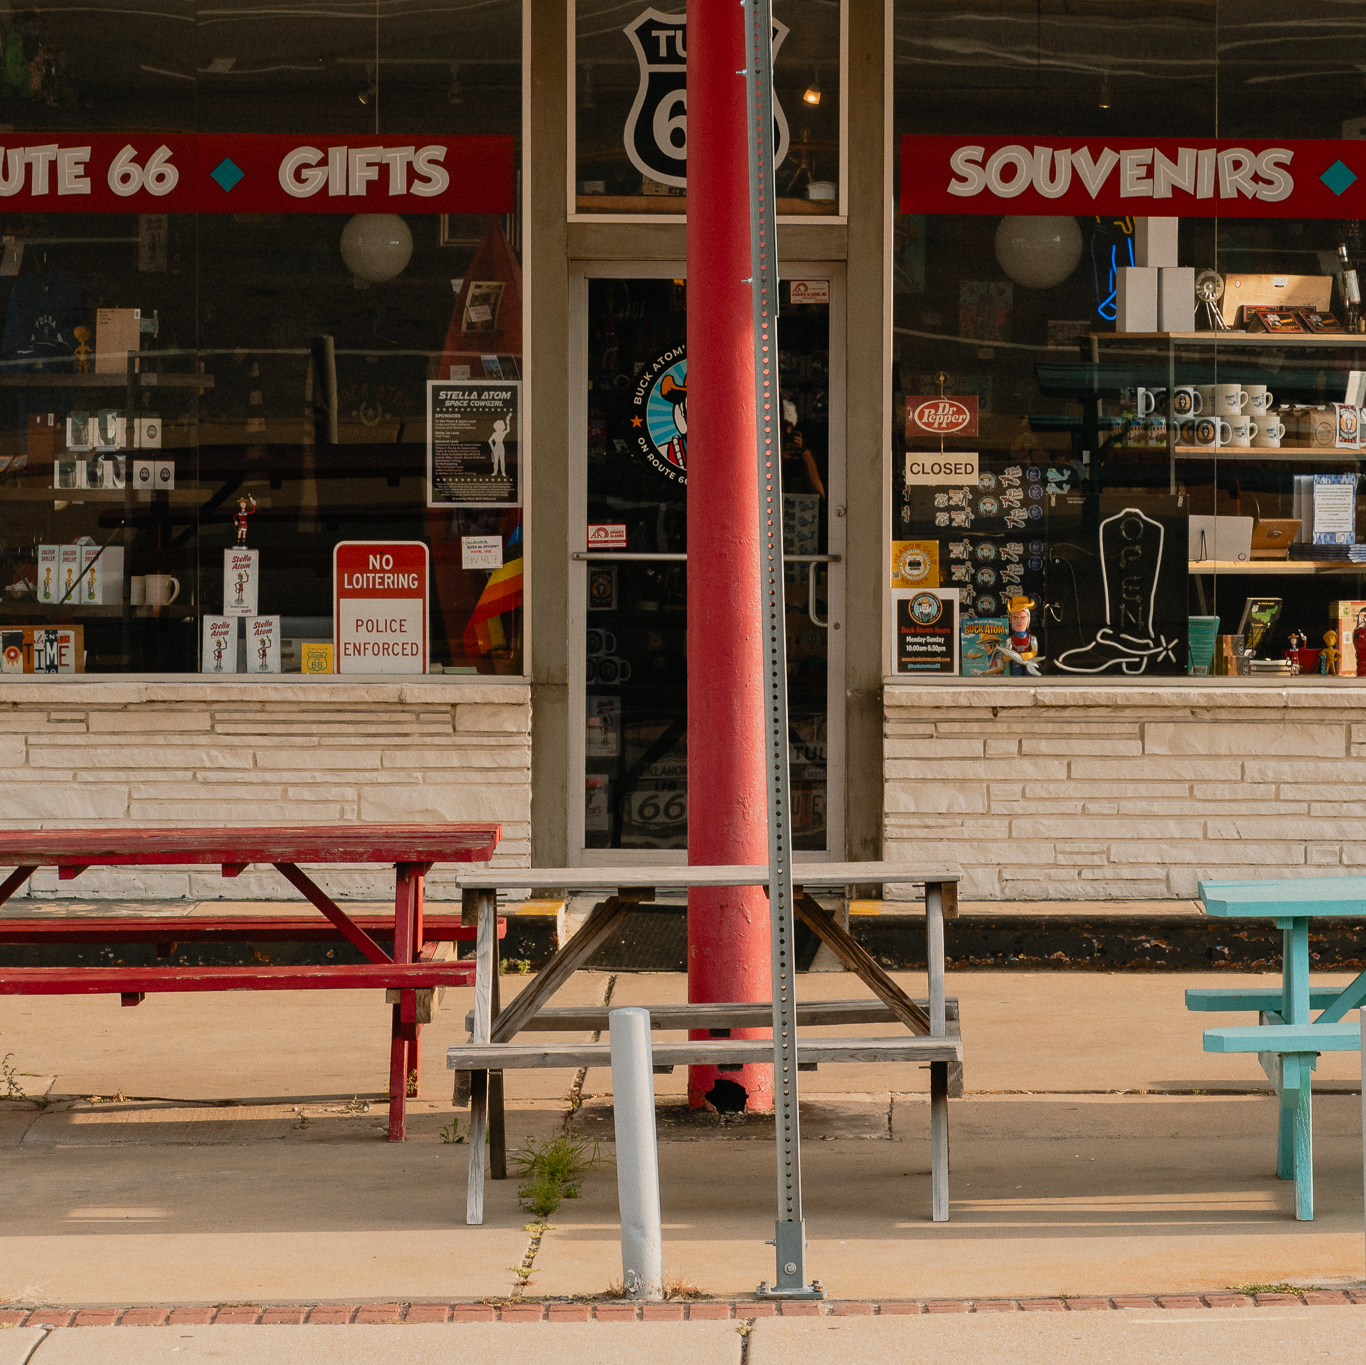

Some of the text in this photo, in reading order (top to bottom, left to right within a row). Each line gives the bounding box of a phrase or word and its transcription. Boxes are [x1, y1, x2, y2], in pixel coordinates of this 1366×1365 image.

[107, 144, 179, 196] 66
[278, 145, 450, 198] GIFTS
[947, 145, 1295, 202] SOUVENIRS
[35, 315, 57, 330] TULSA
[634, 344, 686, 405] BUCK ATOM'
[438, 391, 511, 400] STELLA ATOM
[921, 403, 966, 428] Dr Pepper
[637, 437, 649, 453] ON
[646, 452, 677, 481] ROUTE
[910, 462, 974, 475] CLOSED
[231, 554, 251, 563] Stella
[369, 554, 393, 570] NO
[232, 562, 251, 570] Atom
[344, 573, 419, 589] LOITERING
[210, 622, 230, 630] Stella
[253, 619, 273, 629] Stella
[355, 619, 407, 633] POLICE
[964, 624, 1006, 635] BUCK ATOM
[211, 629, 229, 637] Atom
[254, 628, 272, 636] Atom
[24, 641, 70, 670] TIME
[344, 642, 419, 656] ENFORCED
[311, 661, 323, 669] 66
[638, 794, 685, 821] 66
